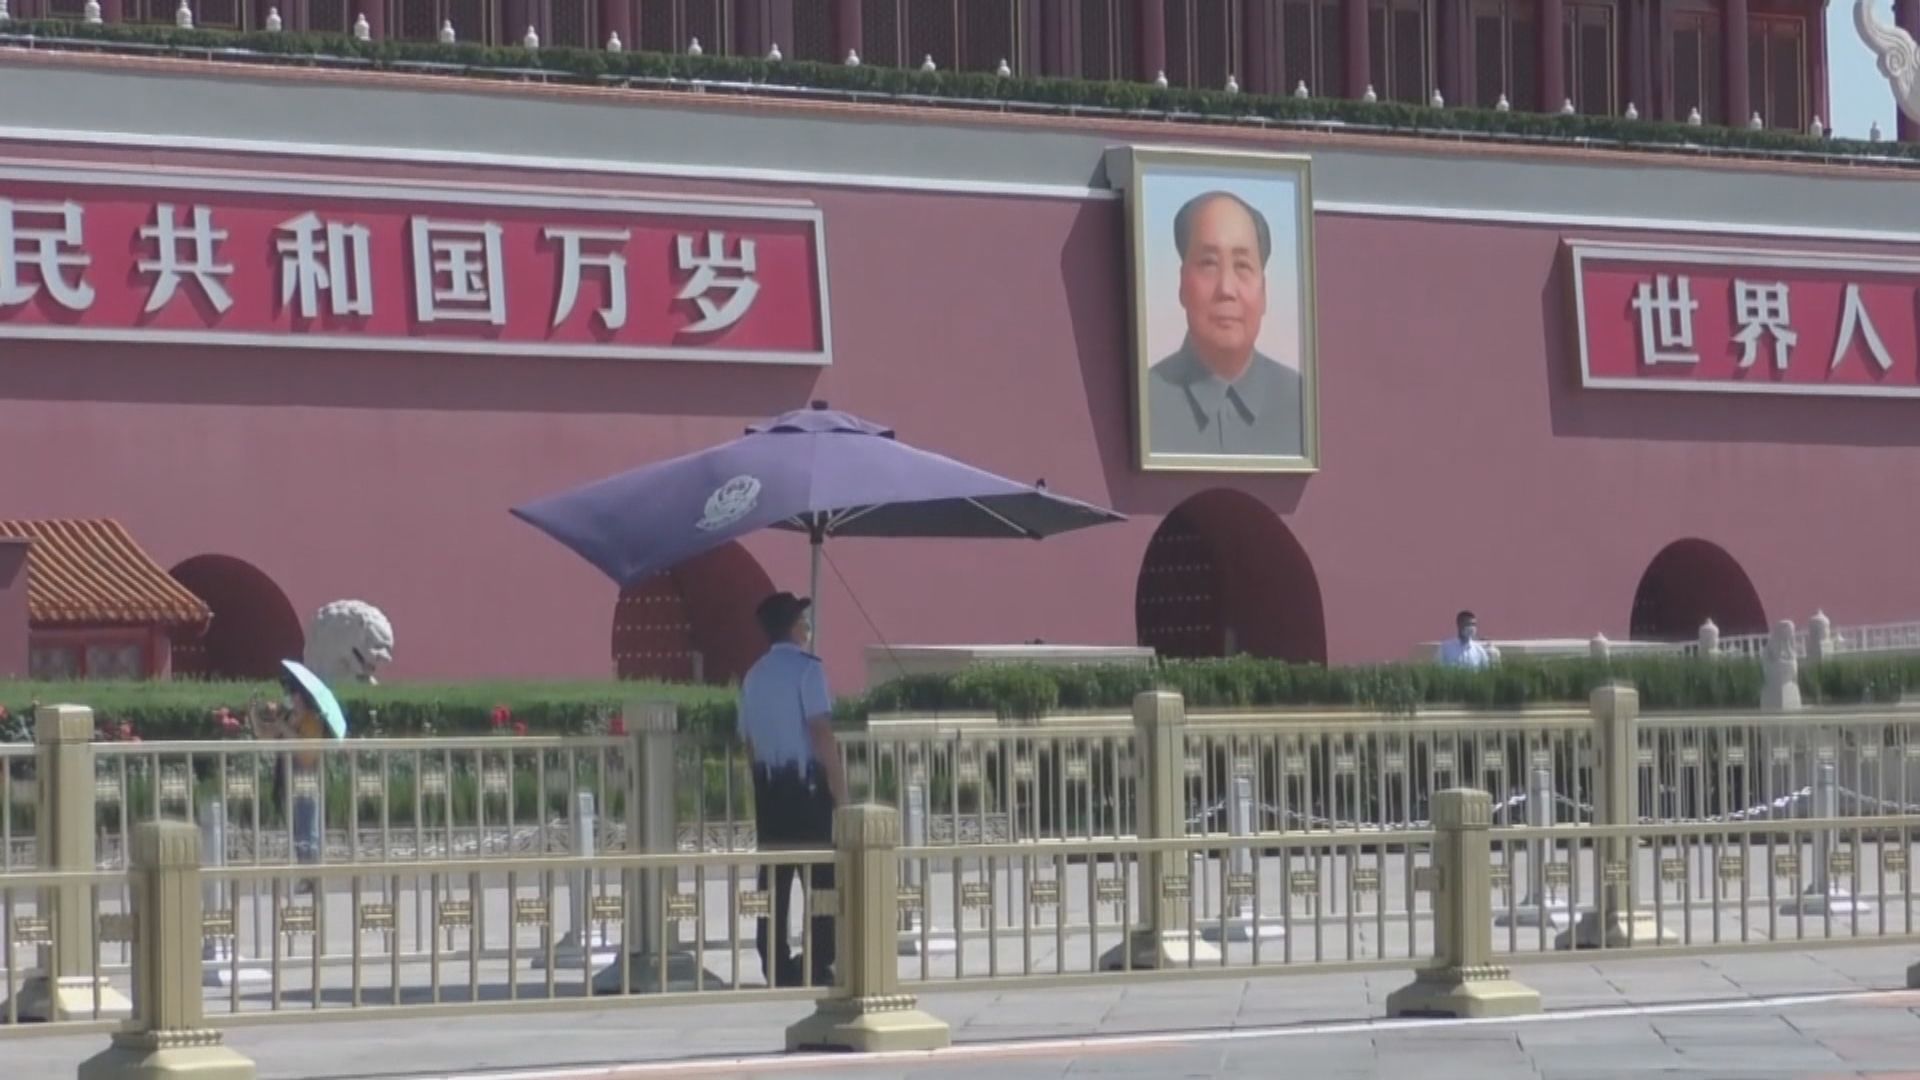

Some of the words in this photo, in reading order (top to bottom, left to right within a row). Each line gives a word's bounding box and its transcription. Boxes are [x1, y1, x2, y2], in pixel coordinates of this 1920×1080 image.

[0, 199, 760, 332] 民共和国万岁
[1632, 275, 1893, 369] 世界人
